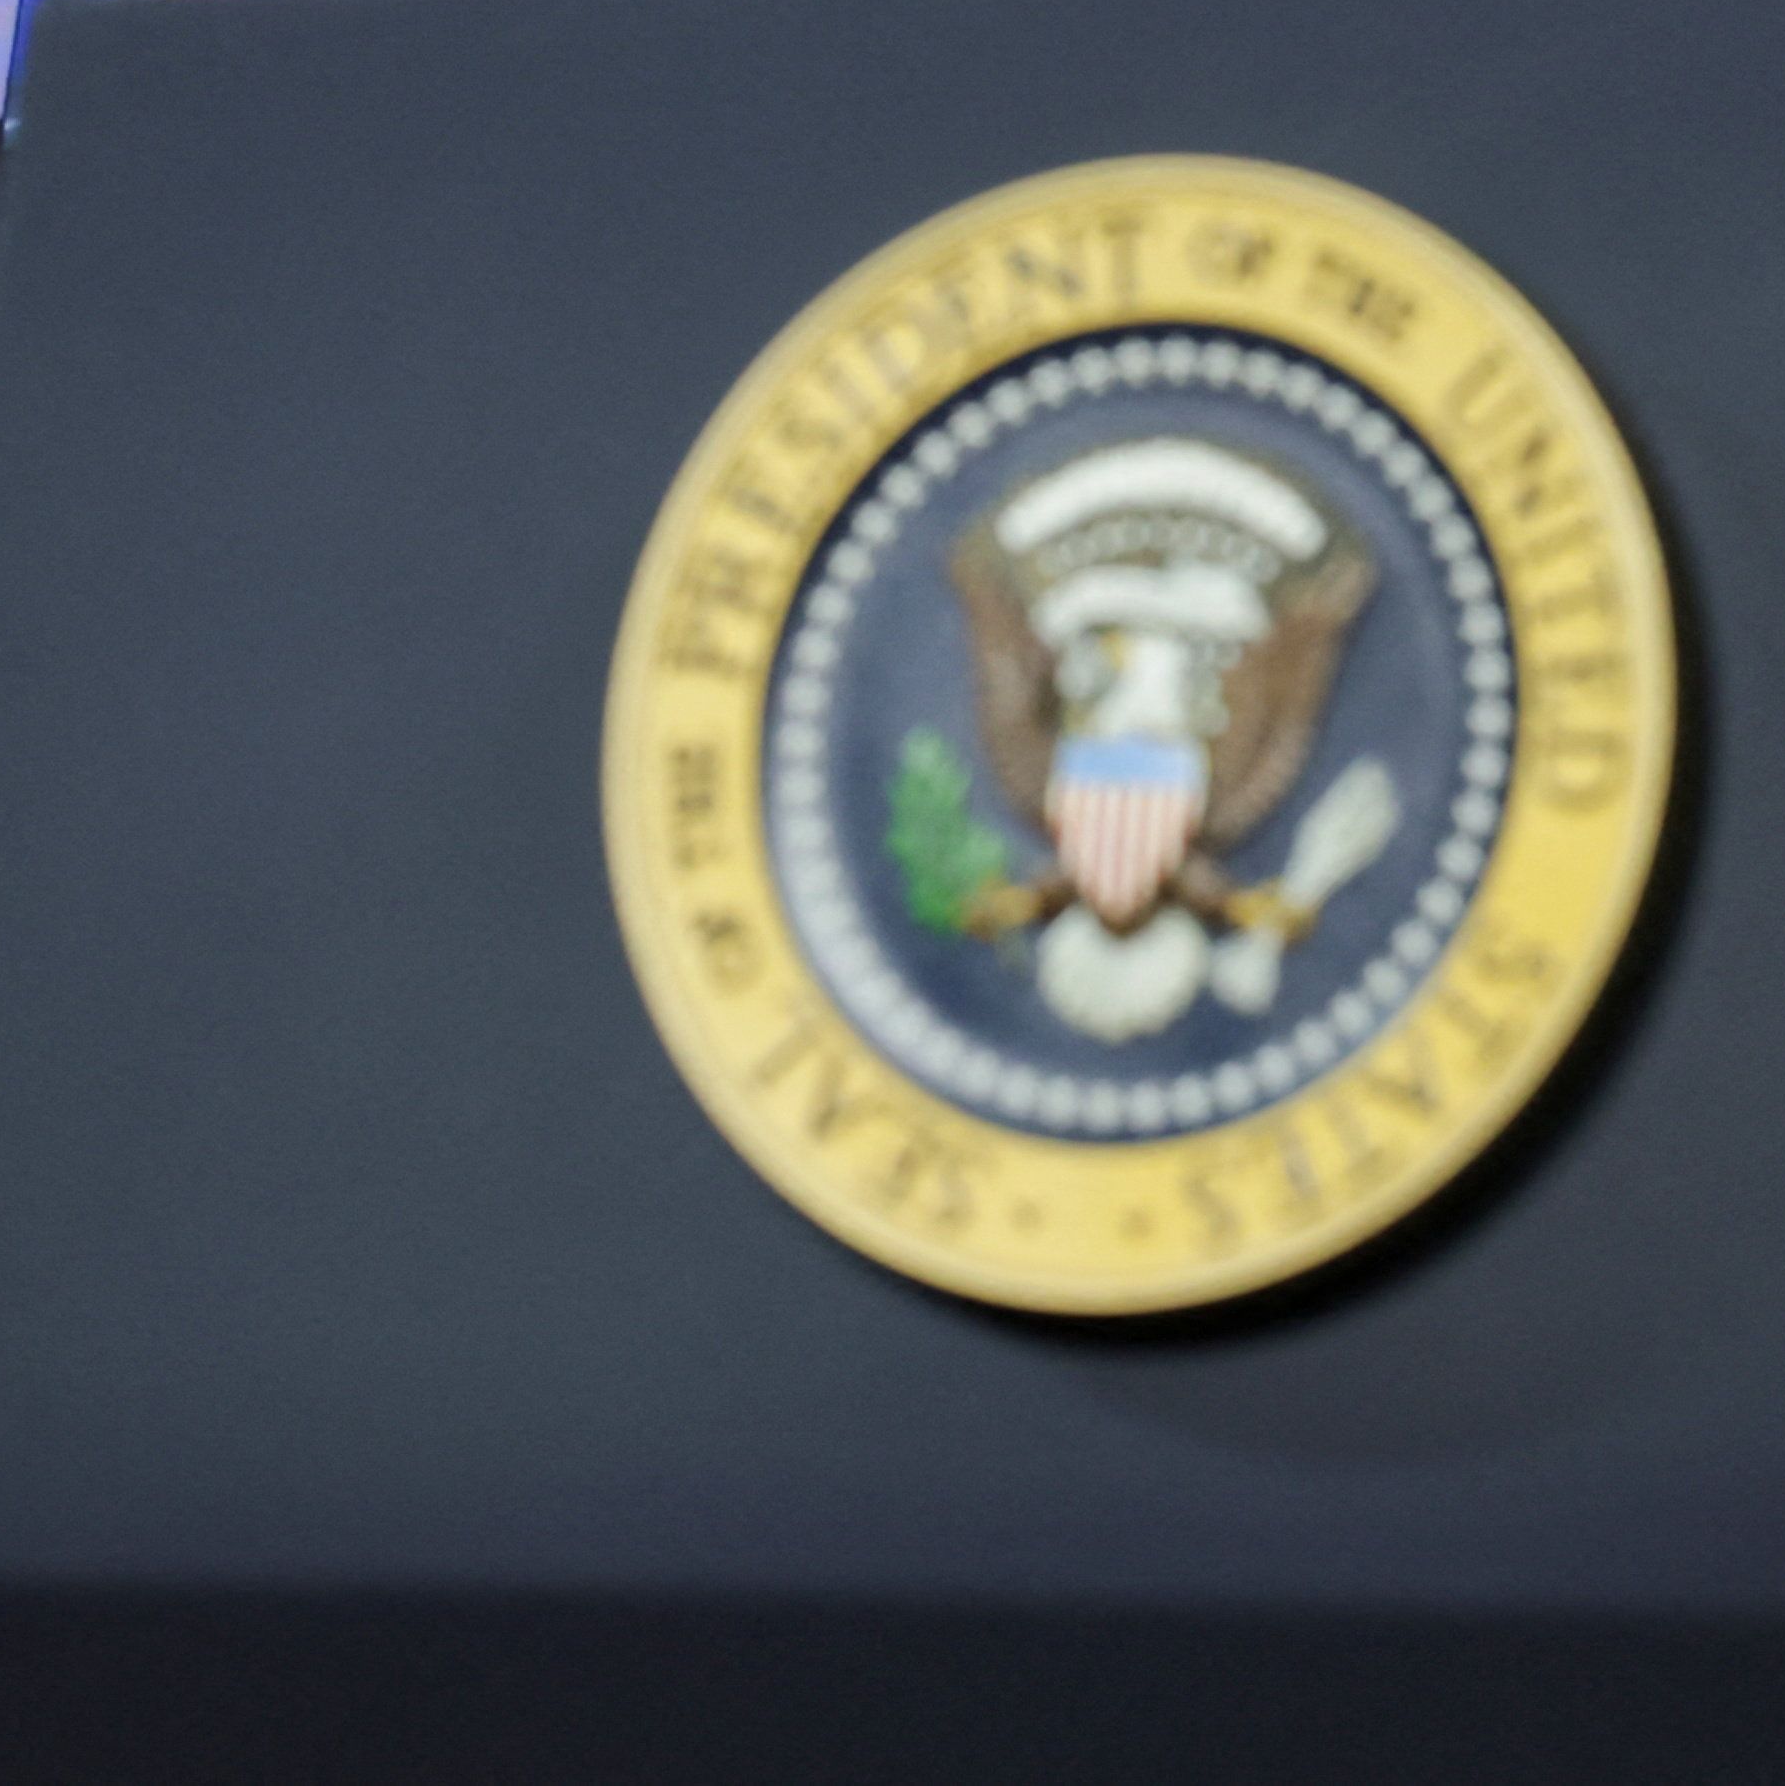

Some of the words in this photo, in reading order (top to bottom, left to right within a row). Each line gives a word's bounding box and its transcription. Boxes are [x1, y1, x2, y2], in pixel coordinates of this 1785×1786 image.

[656, 212, 1150, 680] PRESIDENT
[1440, 338, 1636, 818] UNITED
[754, 1020, 978, 1228] SEAL
[1180, 936, 1552, 1260] STATES
